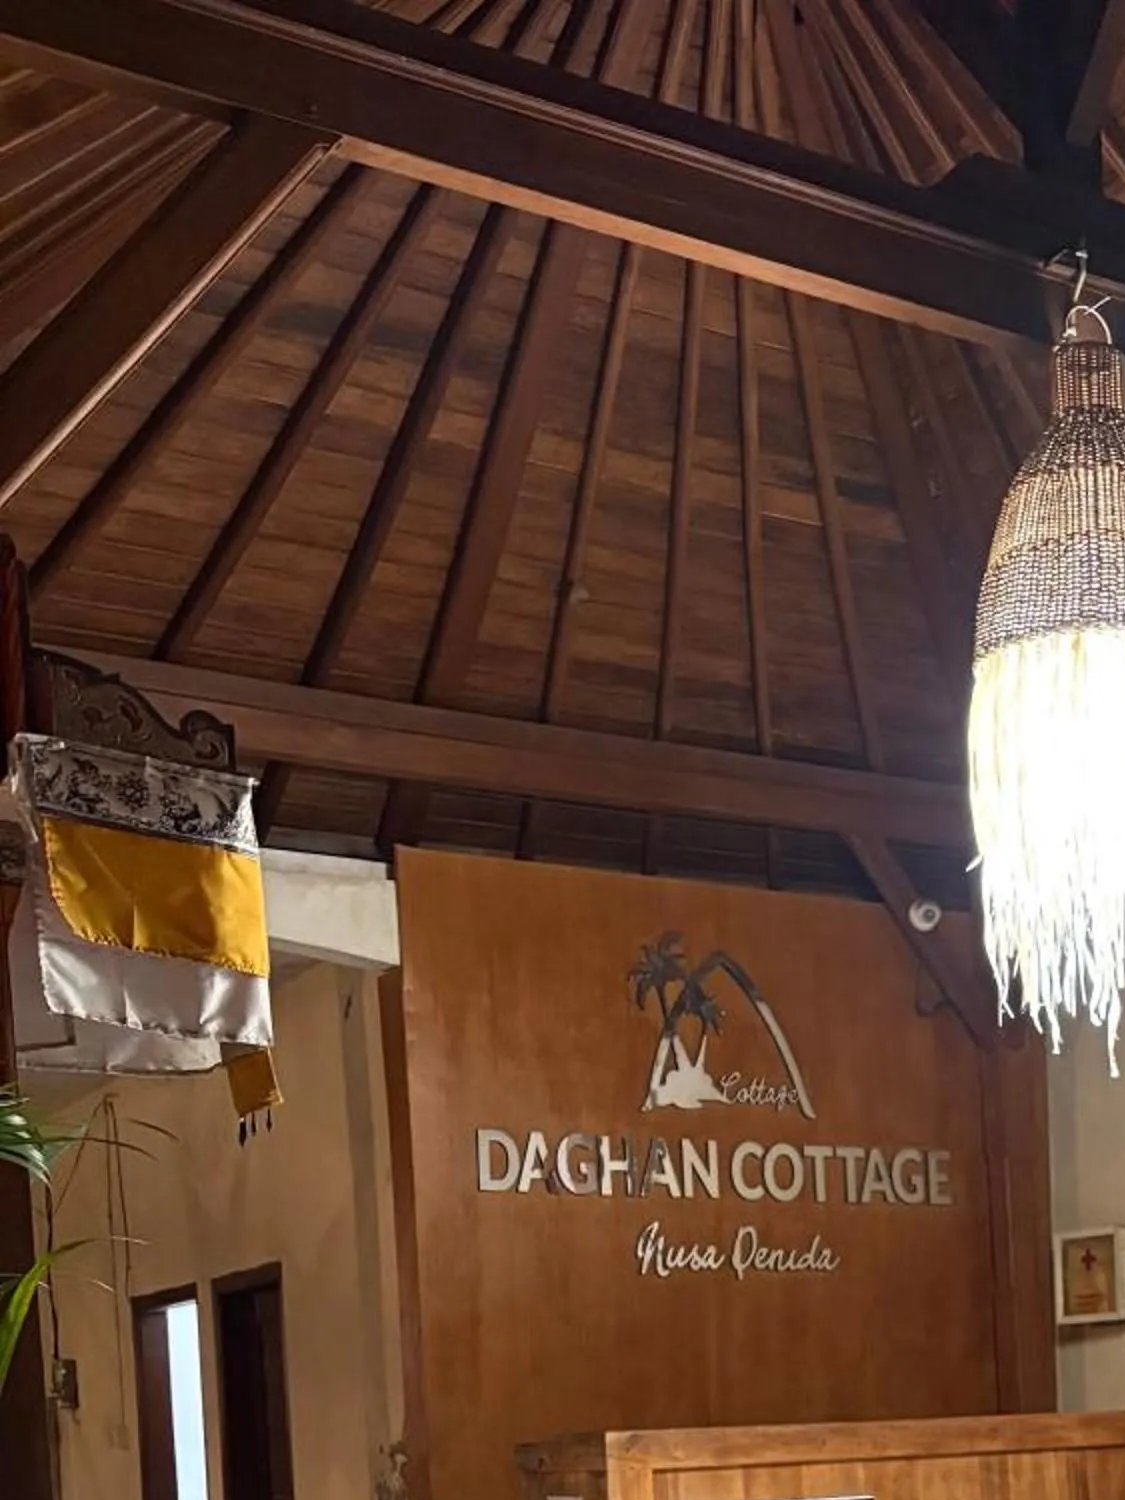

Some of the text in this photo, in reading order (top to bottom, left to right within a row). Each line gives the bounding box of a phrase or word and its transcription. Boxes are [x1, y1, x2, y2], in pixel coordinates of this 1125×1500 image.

[720, 1072, 800, 1111] Cottage
[477, 1128, 954, 1205] DAGHAN COTTAGE
[637, 1220, 840, 1280] Nusa Penida
